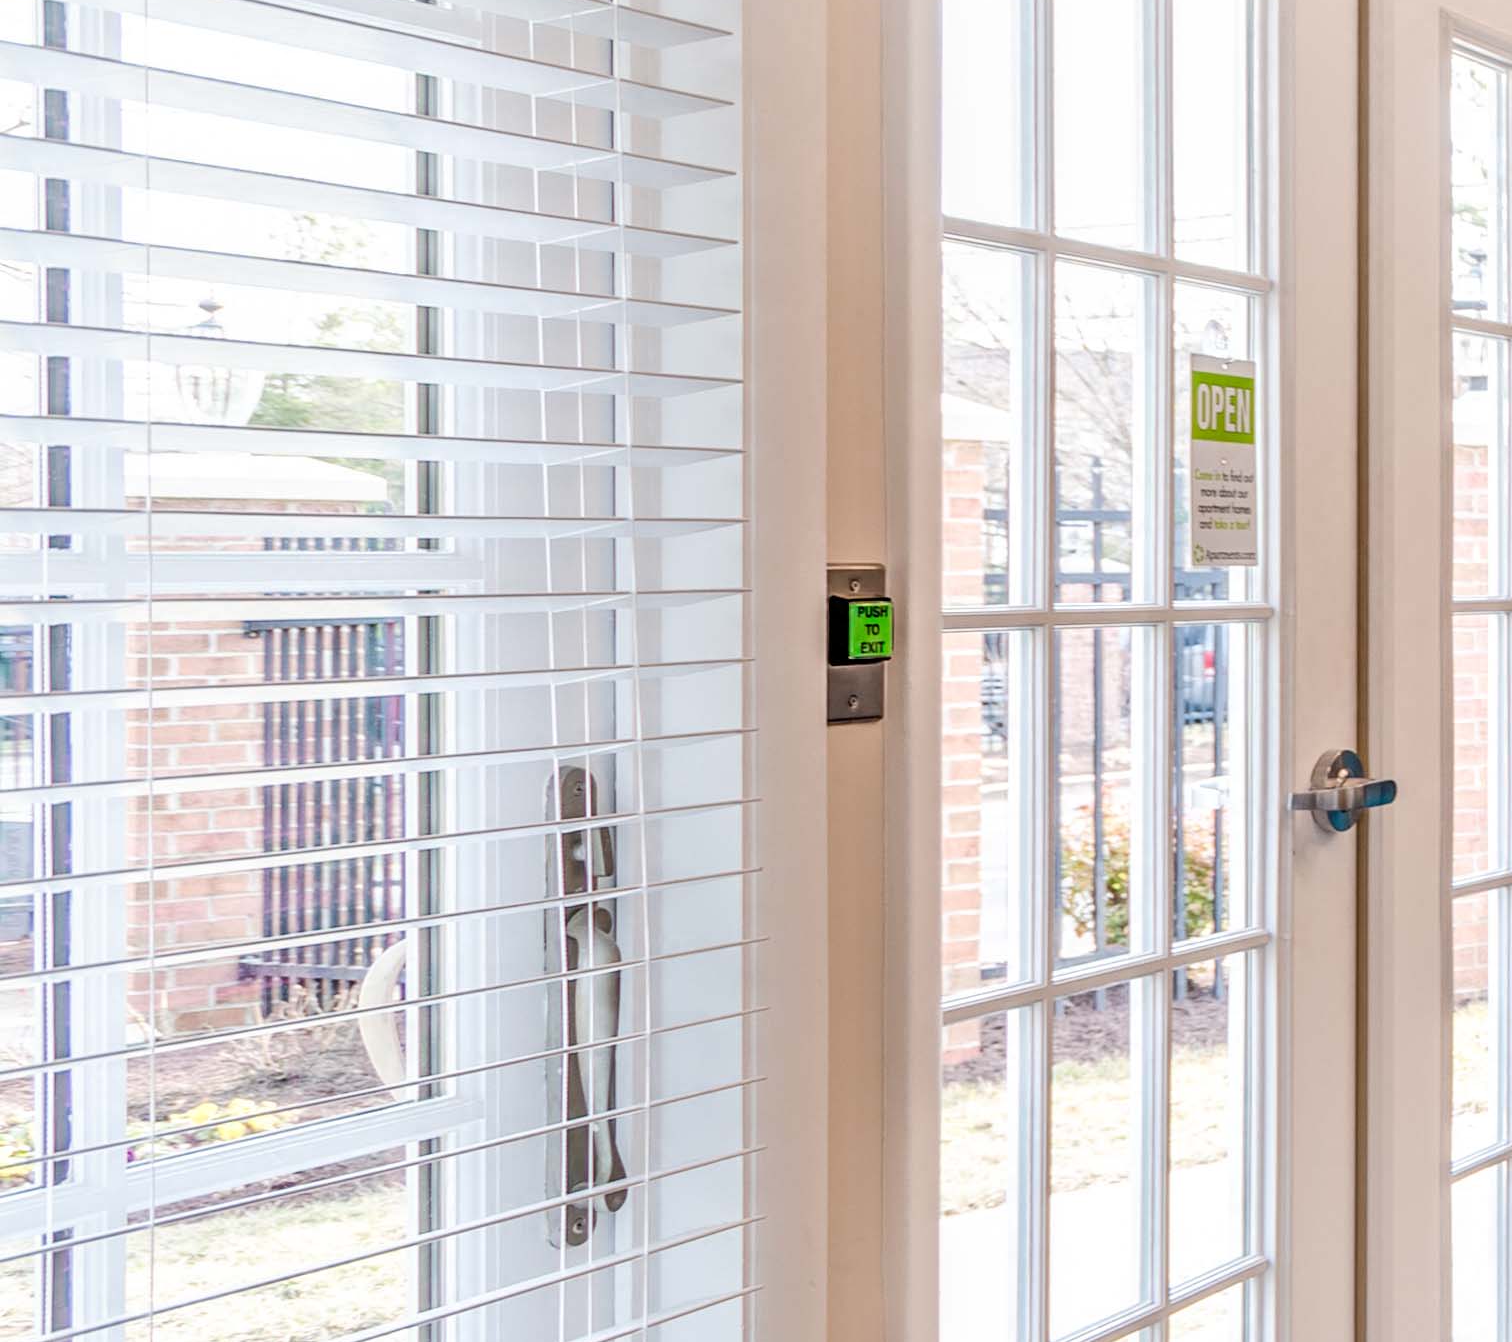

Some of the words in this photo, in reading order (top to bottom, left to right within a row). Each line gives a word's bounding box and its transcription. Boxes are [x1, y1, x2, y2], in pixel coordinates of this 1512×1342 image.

[1197, 383, 1251, 434] OPEN
[857, 605, 888, 618] PUSH
[864, 623, 880, 635] TO
[860, 641, 885, 654] EXIT
